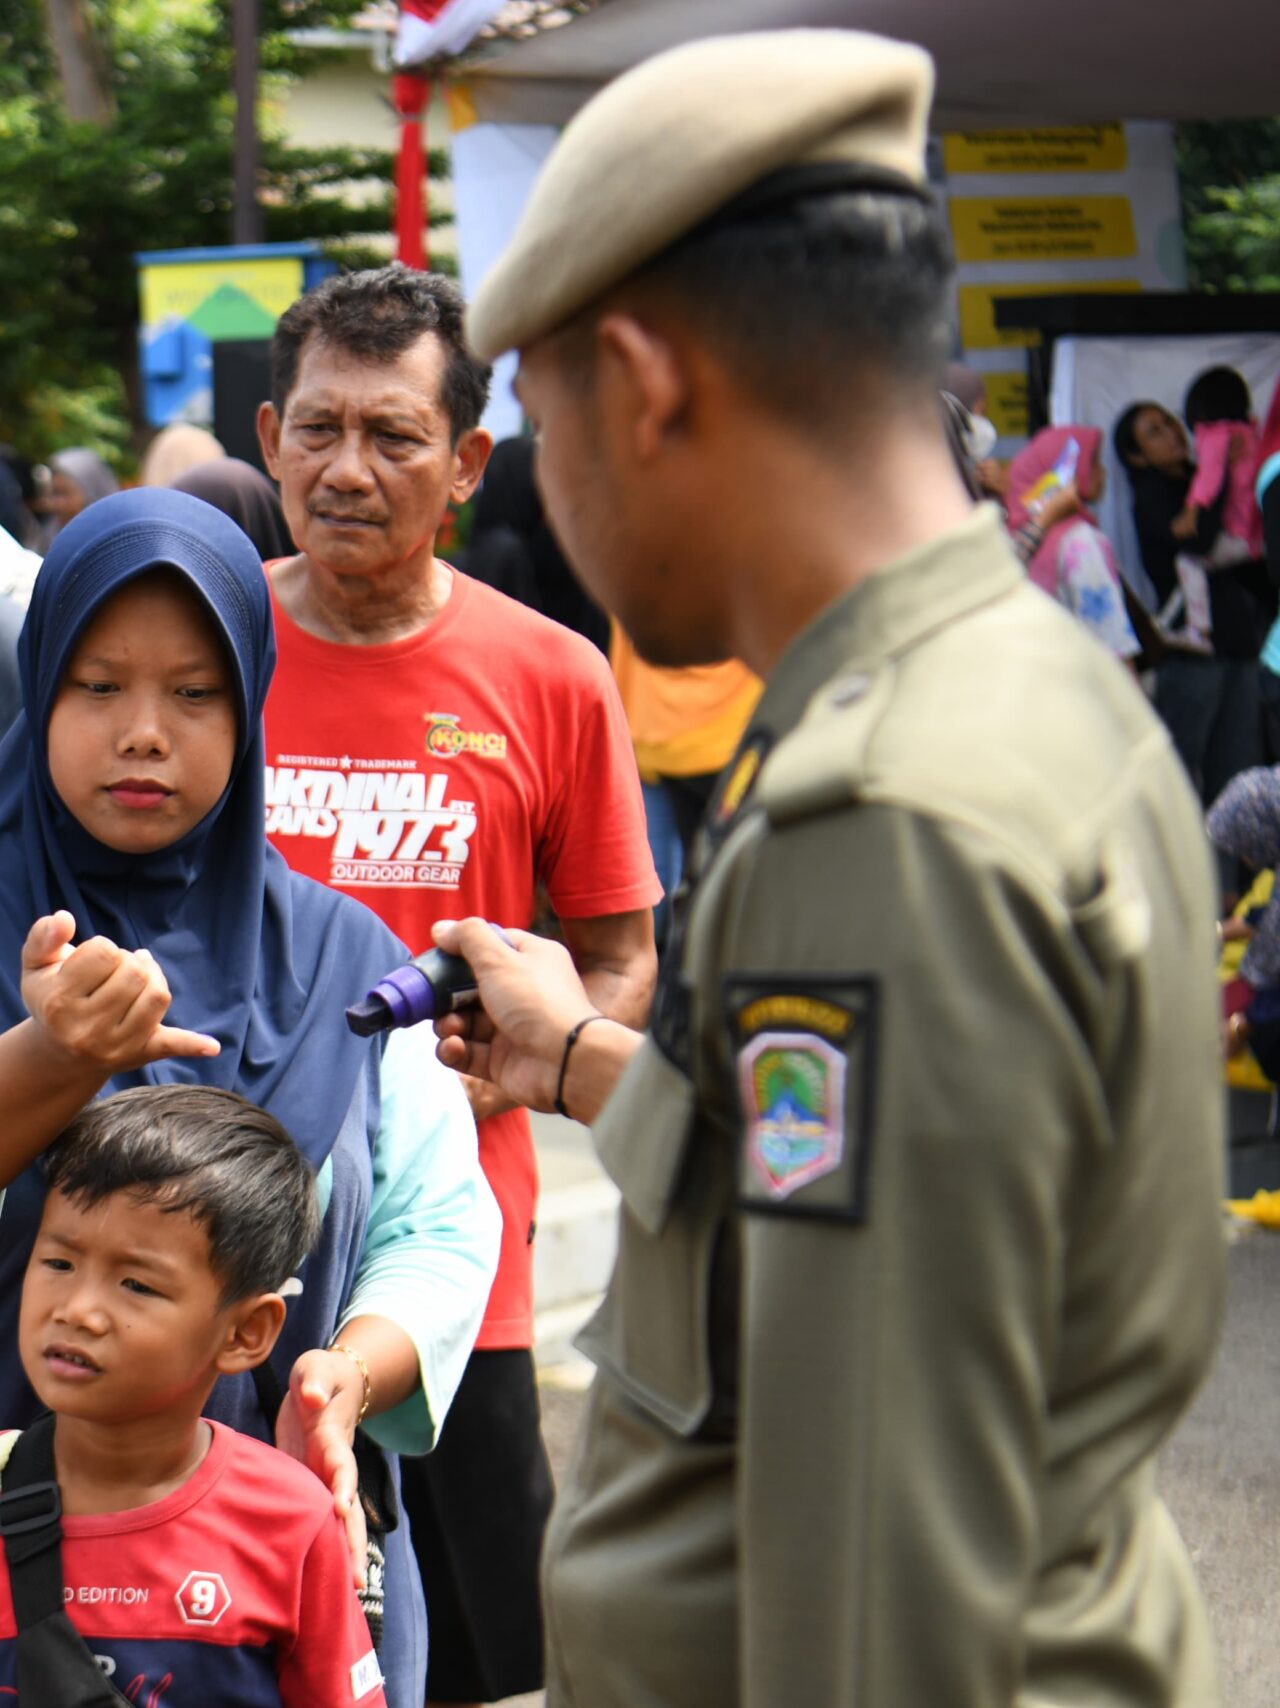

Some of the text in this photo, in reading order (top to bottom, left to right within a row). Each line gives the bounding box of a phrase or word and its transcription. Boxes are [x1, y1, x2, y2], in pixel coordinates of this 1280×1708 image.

[277, 754, 417, 770] REGISTERED TRADEMARK
[332, 863, 461, 883] OUTDOOR GEAR
[78, 1586, 150, 1605] EDITION
[191, 1579, 216, 1616] 9
